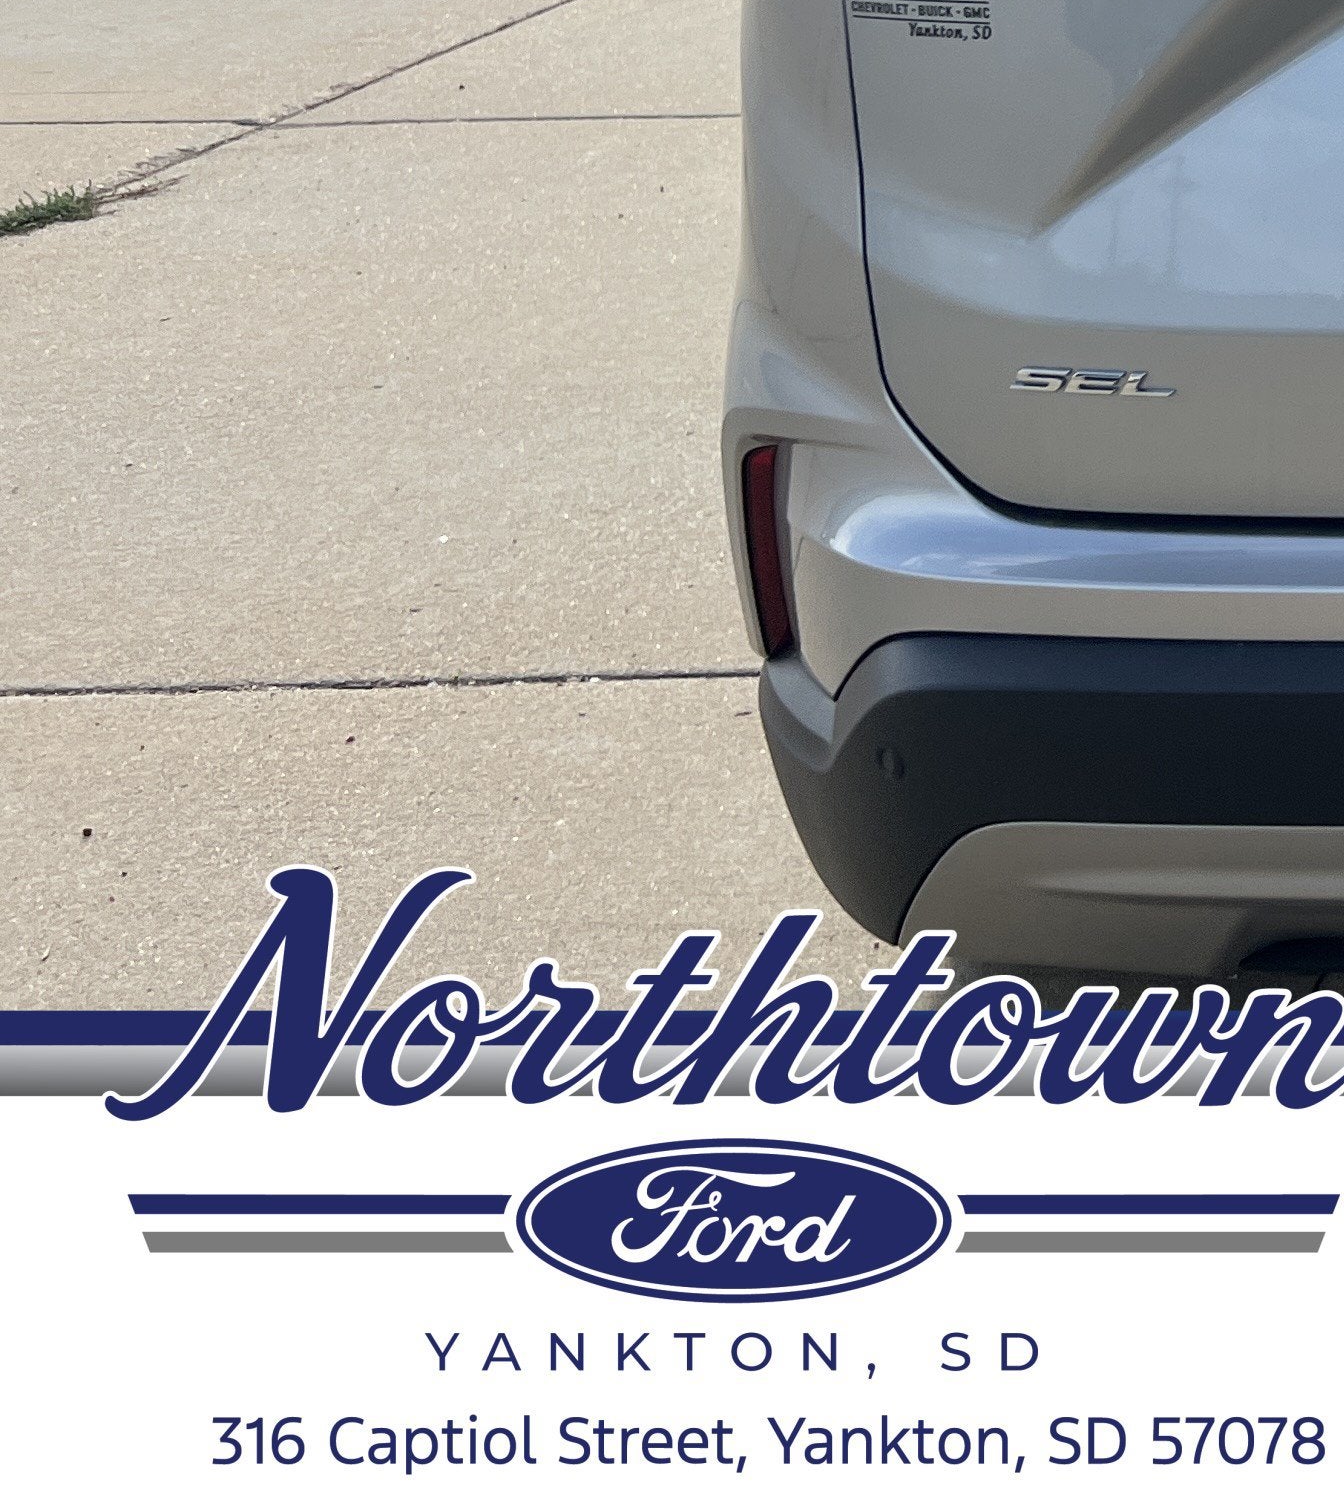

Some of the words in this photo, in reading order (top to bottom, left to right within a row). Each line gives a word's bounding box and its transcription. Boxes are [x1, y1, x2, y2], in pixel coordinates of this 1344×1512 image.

[851, 0, 909, 16] CHEVROLET
[918, 4, 953, 18] BUICK
[963, 6, 990, 19] GMC
[909, 22, 968, 42] Yankton,
[972, 25, 992, 40] SD
[1009, 365, 1177, 398] SEL
